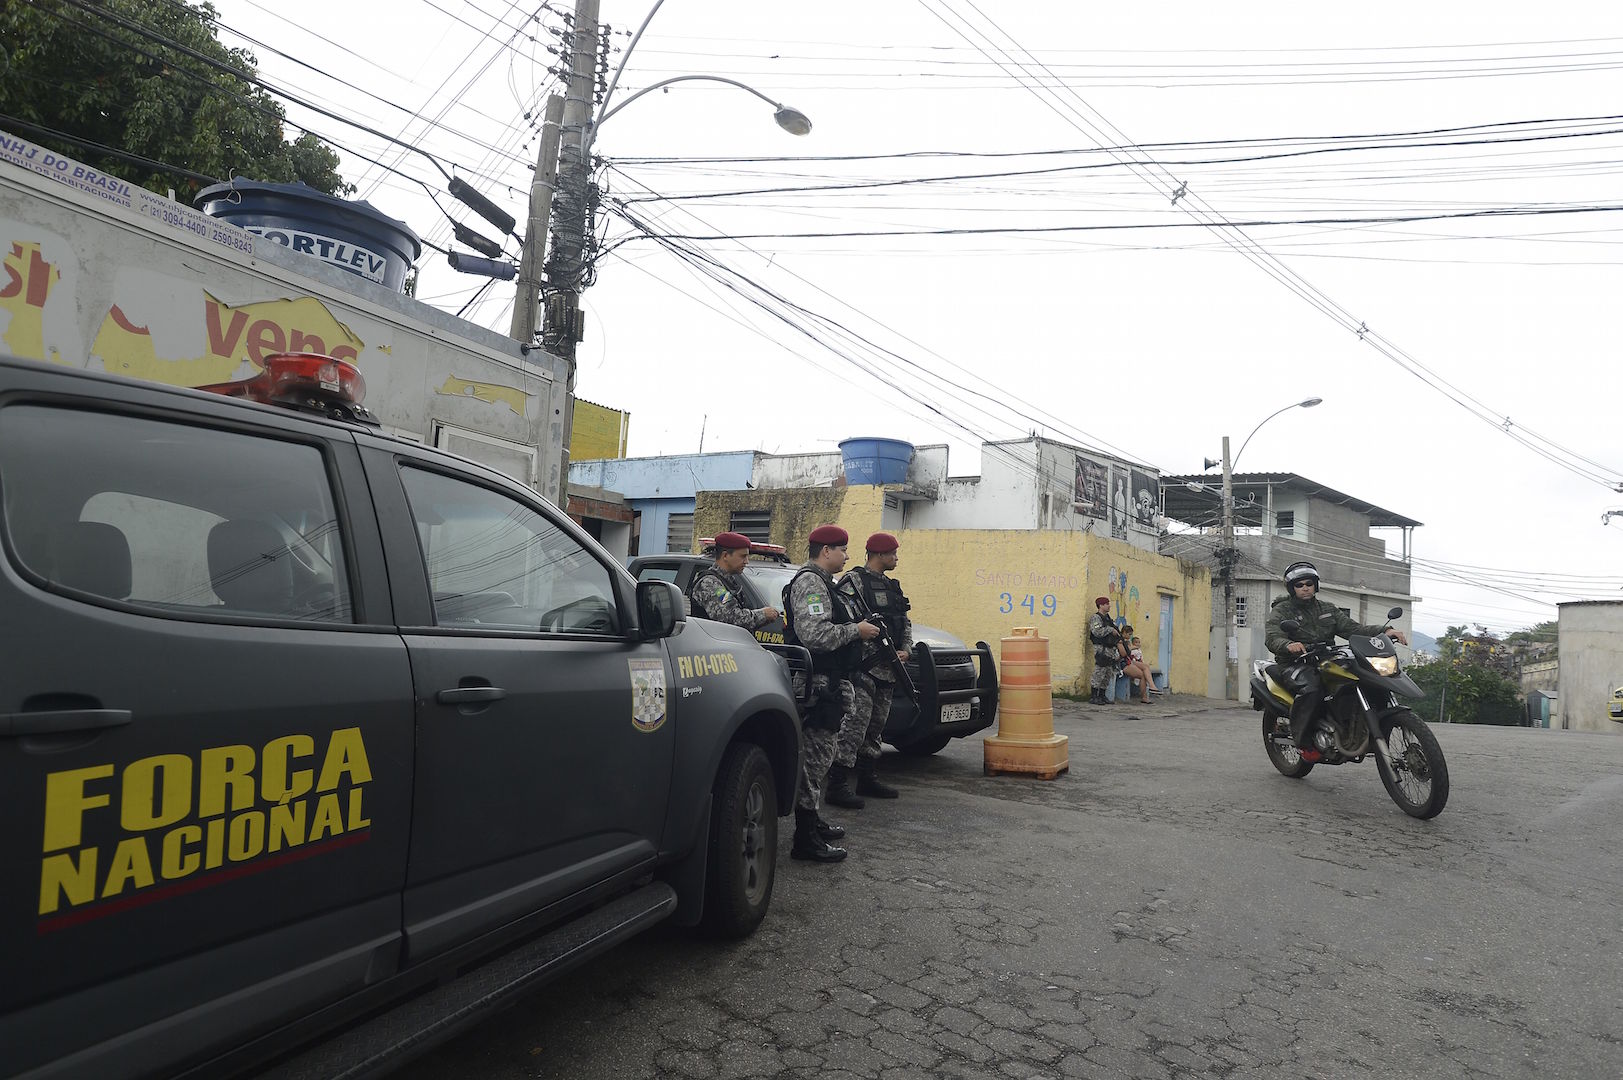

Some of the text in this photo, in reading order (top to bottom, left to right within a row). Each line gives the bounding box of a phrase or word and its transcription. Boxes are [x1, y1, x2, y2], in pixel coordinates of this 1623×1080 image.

[0, 135, 131, 198] NHJ DO BRASIL
[53, 172, 131, 208] HABITACIONAIS
[976, 569, 1078, 589] SANTO AMARO
[677, 655, 694, 679] FN
[694, 652, 738, 677] 01-0736
[43, 727, 373, 853] FORÇA
[38, 787, 371, 915] NACIONAL
